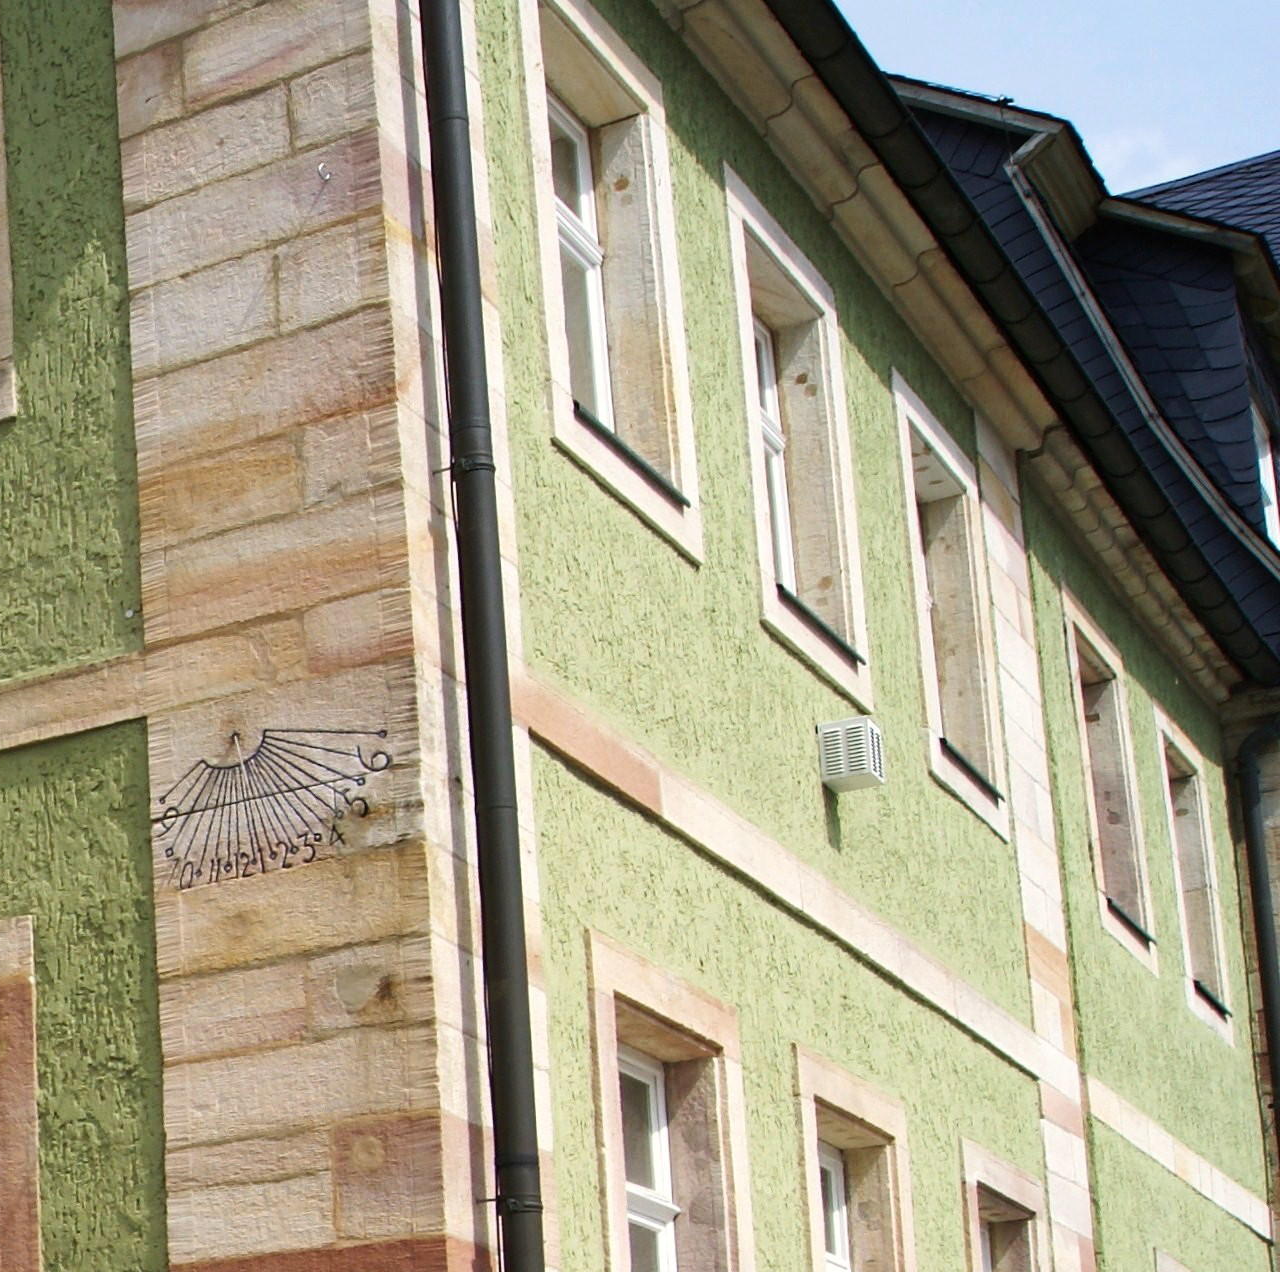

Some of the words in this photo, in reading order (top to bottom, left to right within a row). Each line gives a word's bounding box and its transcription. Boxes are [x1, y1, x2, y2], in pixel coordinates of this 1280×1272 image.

[234, 852, 256, 878] 12
[276, 841, 292, 869] 2
[297, 833, 316, 863] 3
